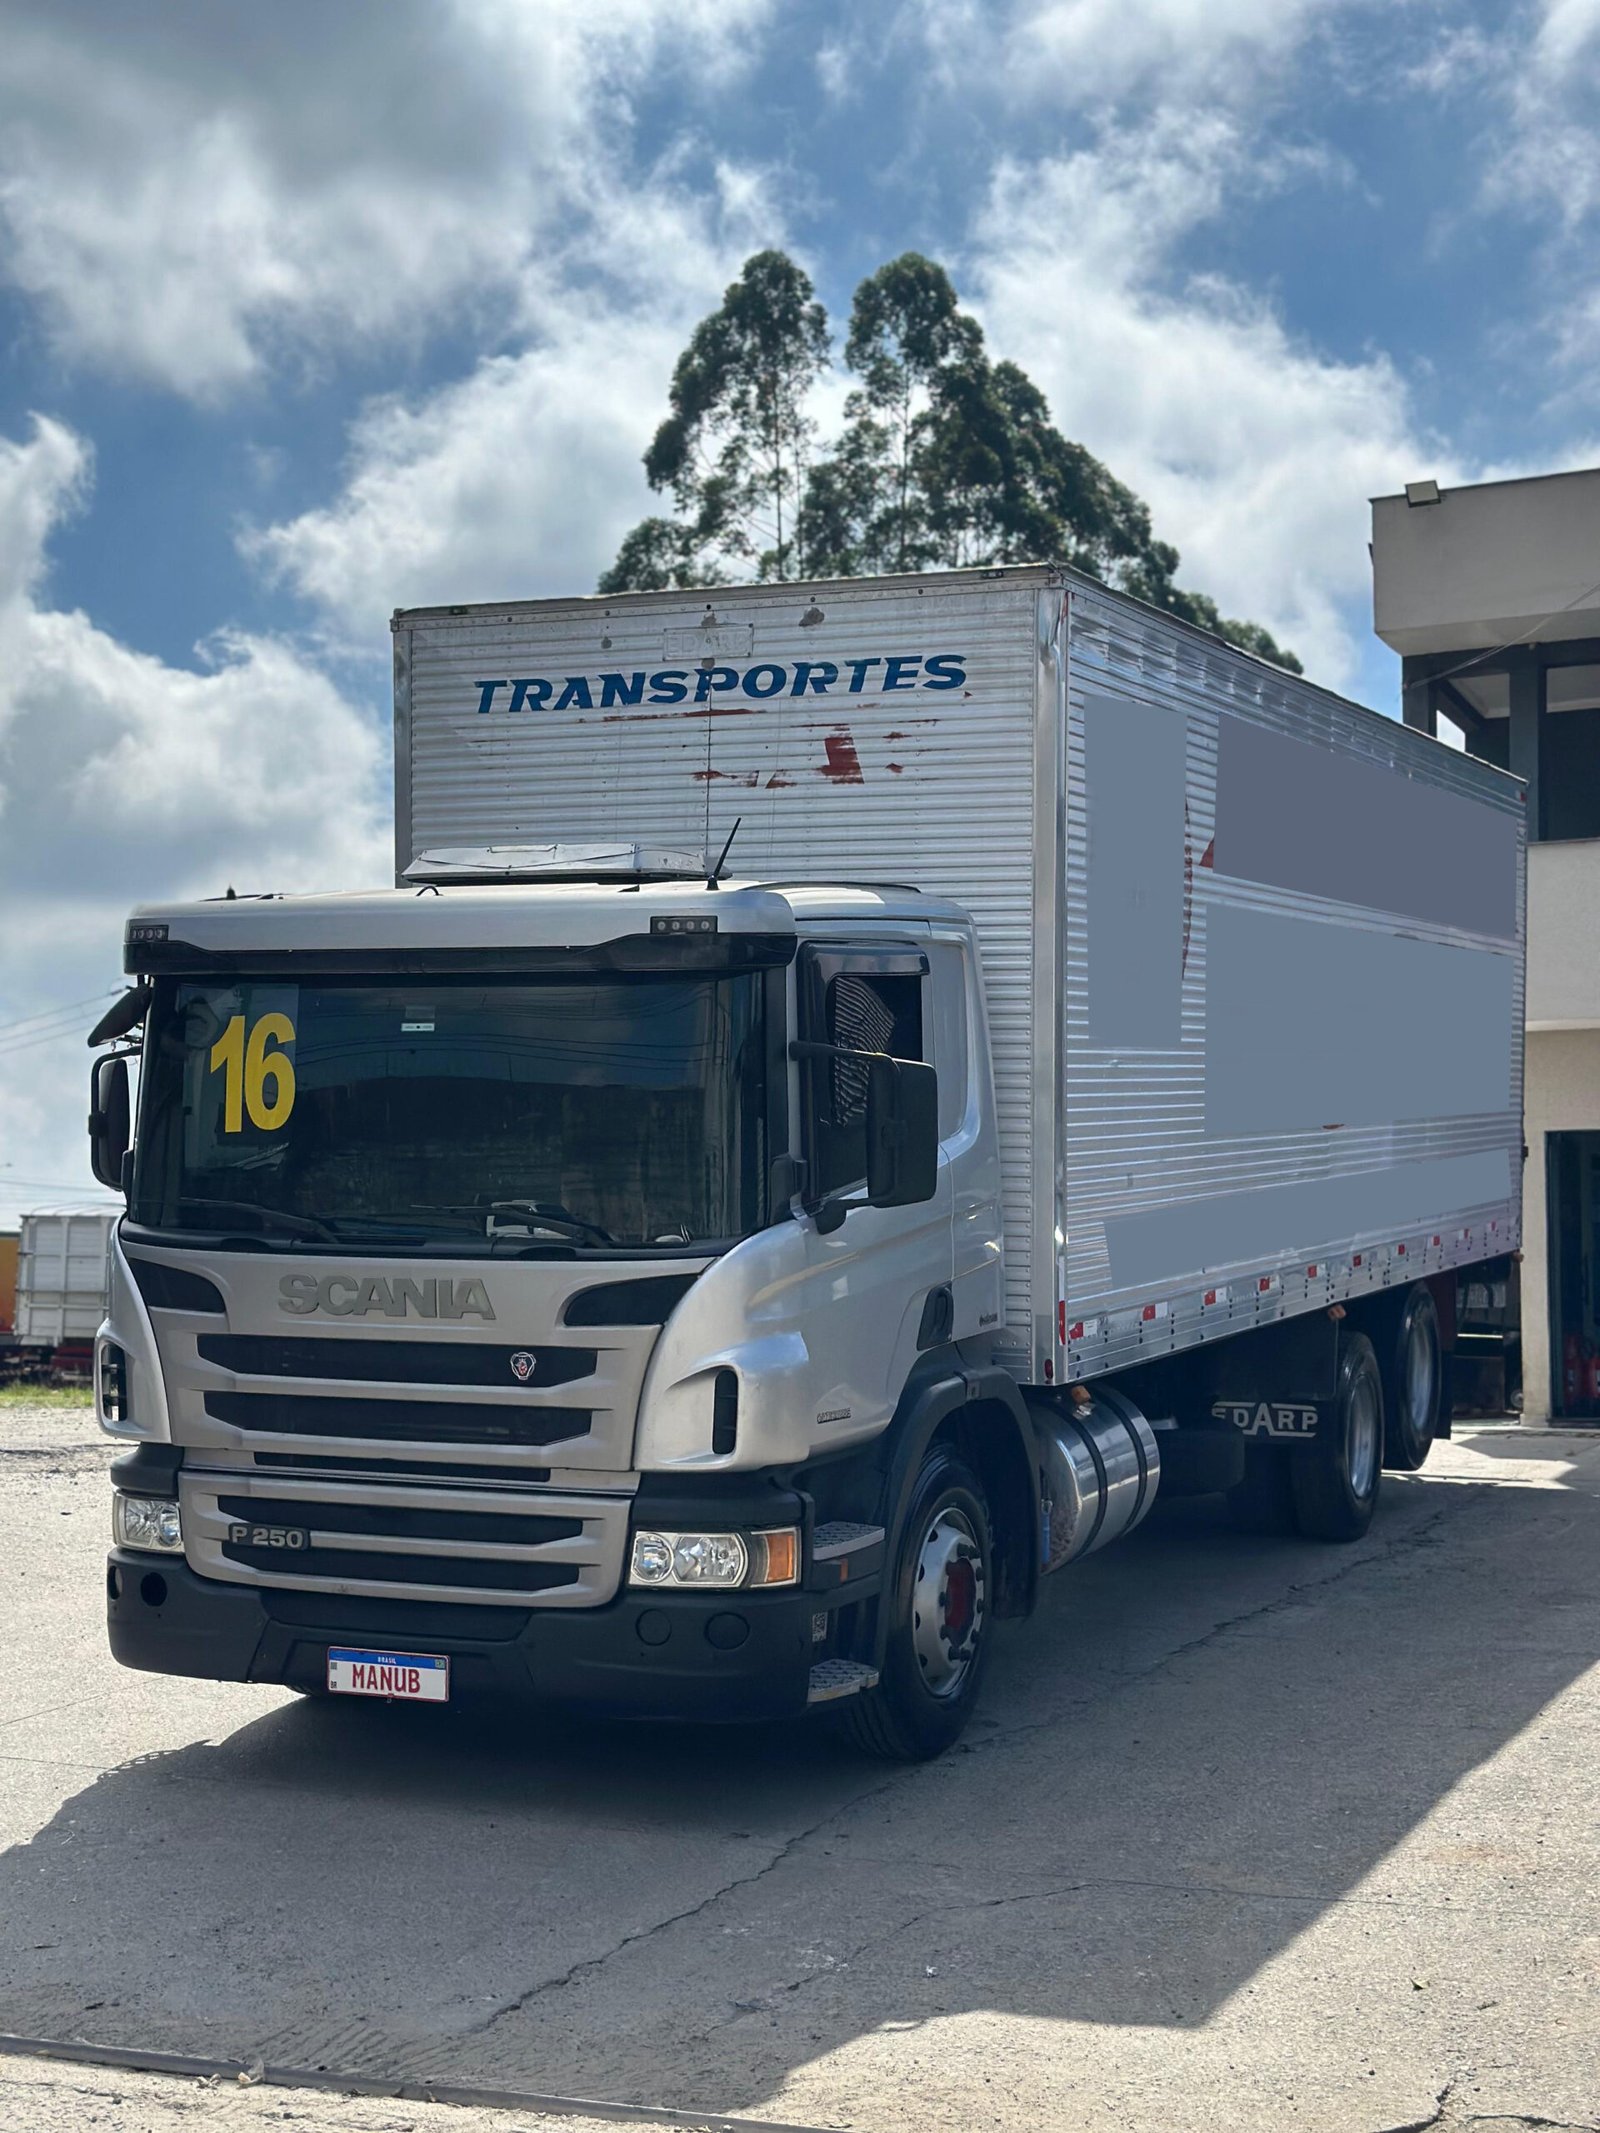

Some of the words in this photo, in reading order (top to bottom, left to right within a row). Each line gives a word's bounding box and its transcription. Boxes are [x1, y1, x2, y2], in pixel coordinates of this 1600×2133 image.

[473, 654, 967, 714] TRANSPORTES
[210, 1012, 296, 1132] 16
[278, 1273, 497, 1320] SCANIA
[232, 1526, 248, 1543] P
[252, 1528, 303, 1548] 250
[352, 1663, 421, 1694] MANUB
[377, 1656, 397, 1665] BRASIL
